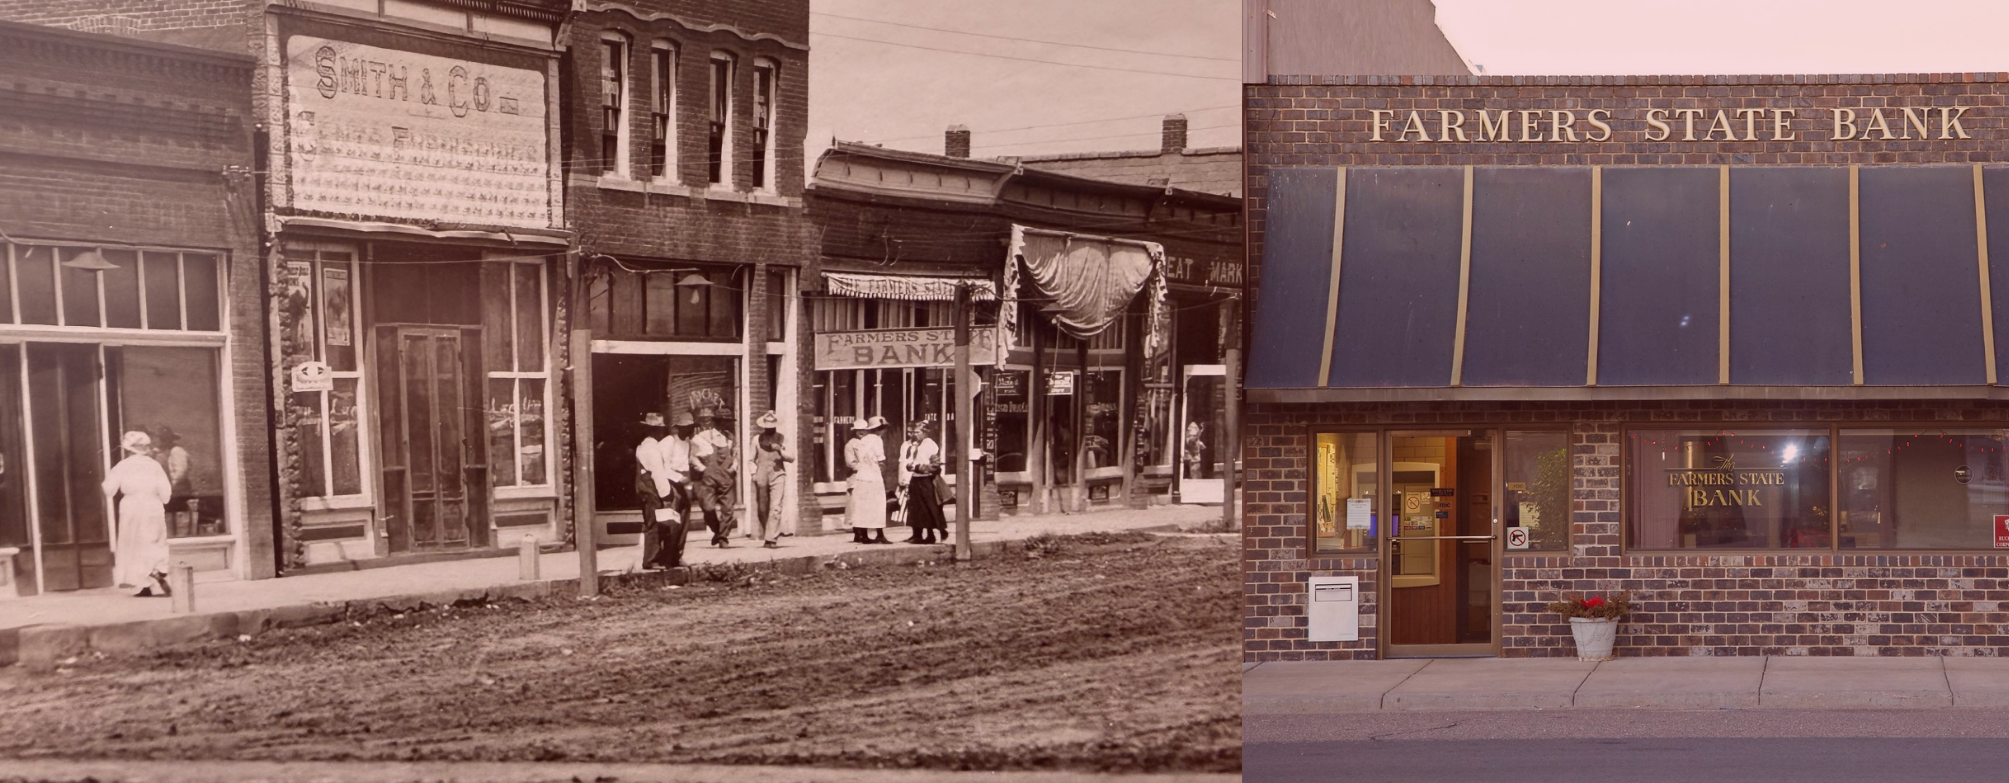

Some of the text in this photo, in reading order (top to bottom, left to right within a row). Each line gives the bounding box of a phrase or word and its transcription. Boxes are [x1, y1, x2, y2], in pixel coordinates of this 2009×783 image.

[421, 67, 437, 105] &
[1369, 107, 1972, 142] FARMERS STATE BANK
[1166, 256, 1194, 280] EAT
[825, 329, 993, 355] FARMERS STTE
[852, 343, 955, 365] BANK
[1713, 453, 1736, 471] The
[1669, 472, 1785, 485] FARMERS STATE
[1693, 489, 1762, 506] BANK
